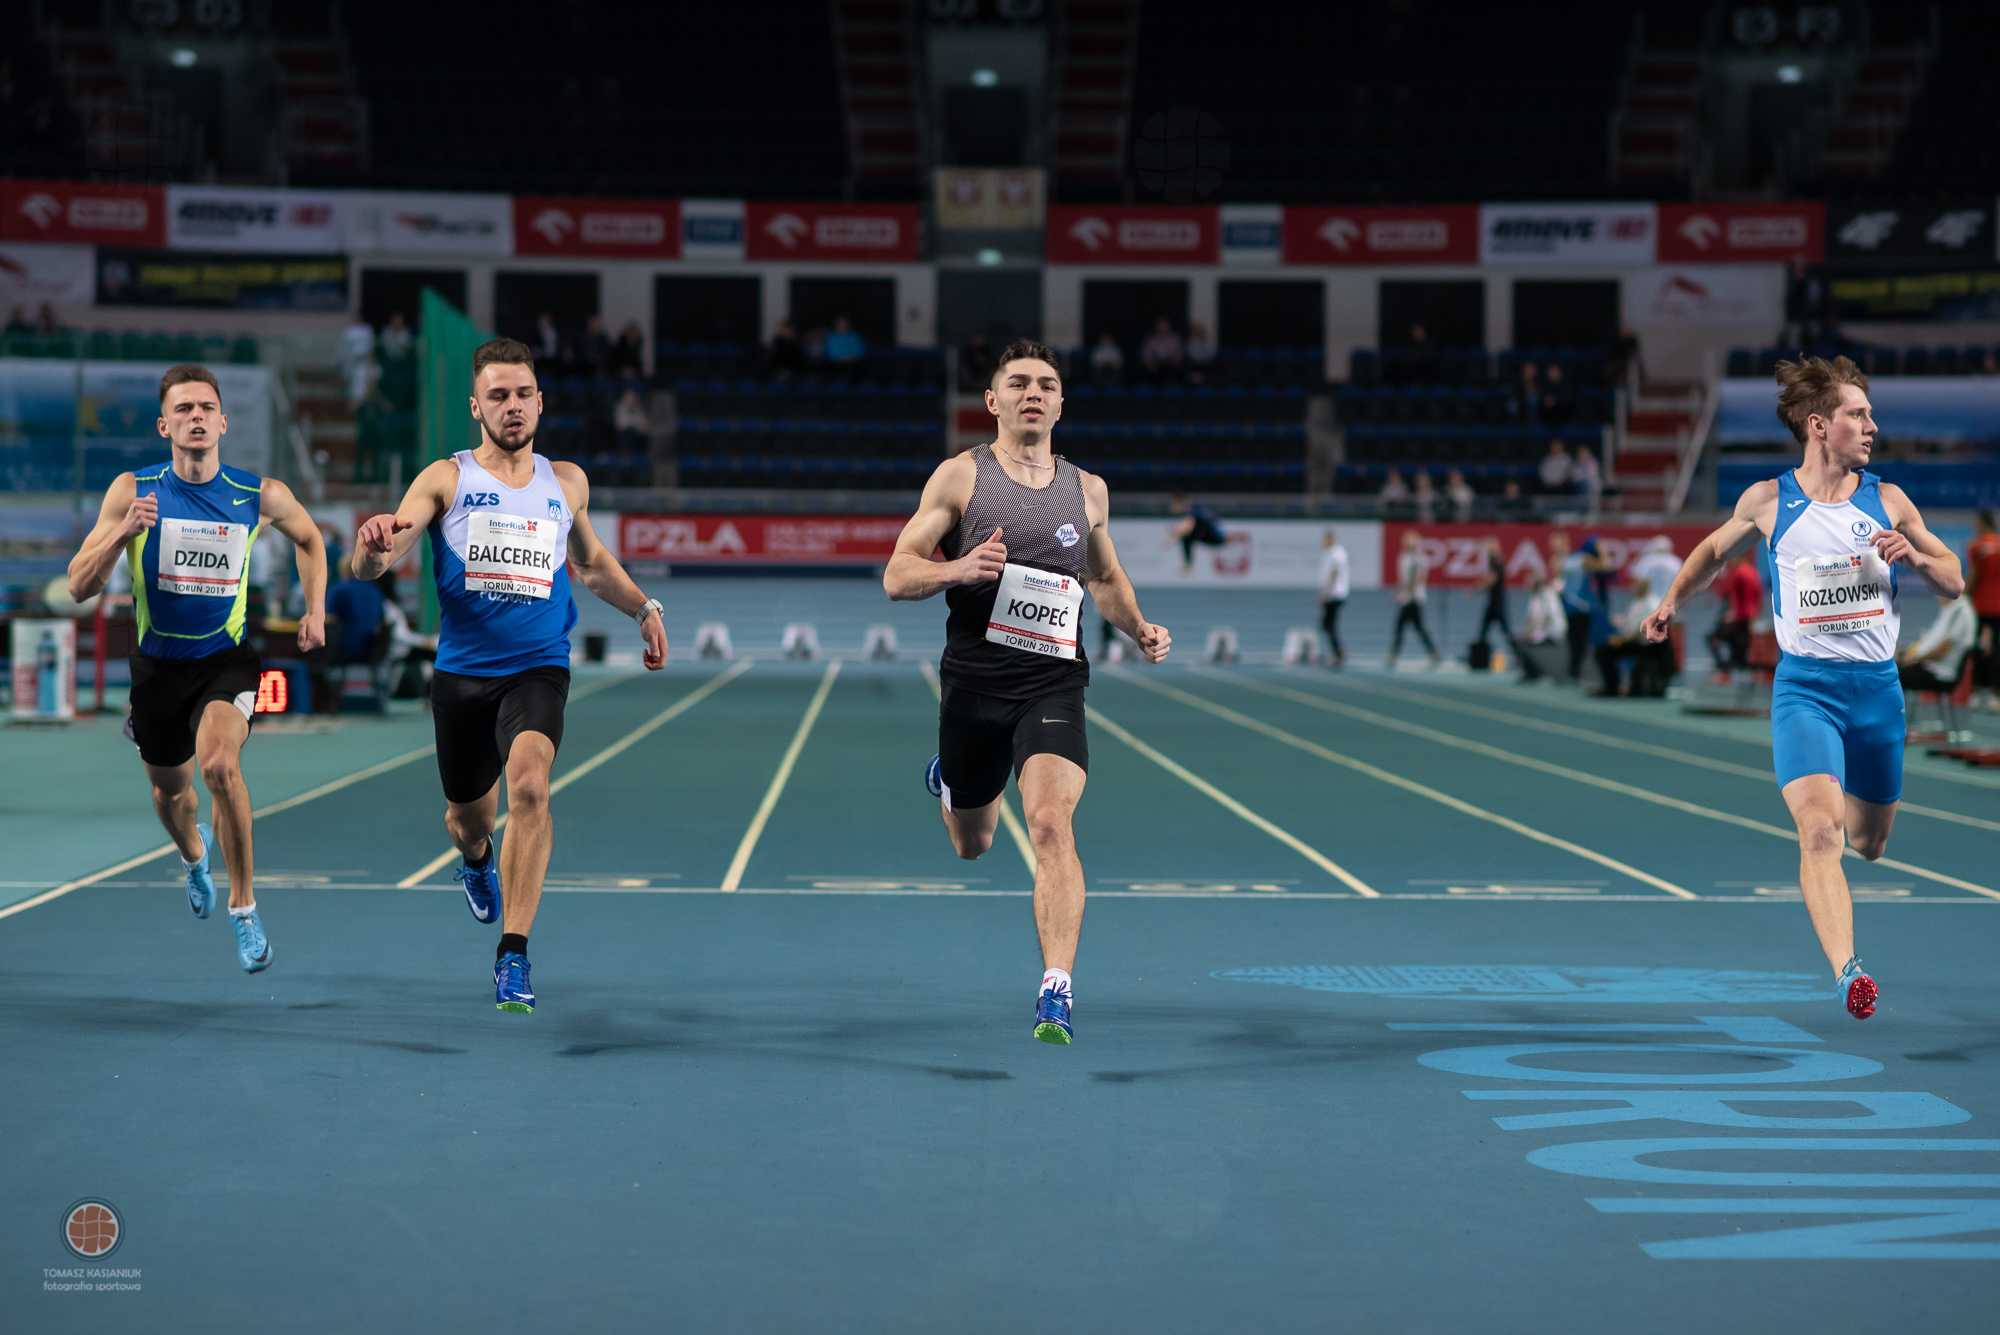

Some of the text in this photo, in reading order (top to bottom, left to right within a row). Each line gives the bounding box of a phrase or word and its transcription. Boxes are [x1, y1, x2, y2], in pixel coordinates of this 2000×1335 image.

[462, 493, 500, 507] AZS
[182, 526, 217, 536] InterRisk
[489, 520, 526, 531] InterRisk
[624, 519, 747, 555] PZLA
[174, 550, 229, 570] DZIDA
[469, 545, 551, 570] BALCEREK
[1814, 562, 1850, 571] InterRisk
[174, 583, 226, 594] TORUŃ 2019
[483, 581, 536, 594] TORUŃ 2019
[1024, 574, 1060, 589] InterRisk
[1800, 583, 1879, 607] KOZŁOWSKI
[1008, 598, 1068, 627] KOPEĆ
[1818, 620, 1870, 632] TORUŃ 2019
[1005, 635, 1060, 654] TORUŃ 2019
